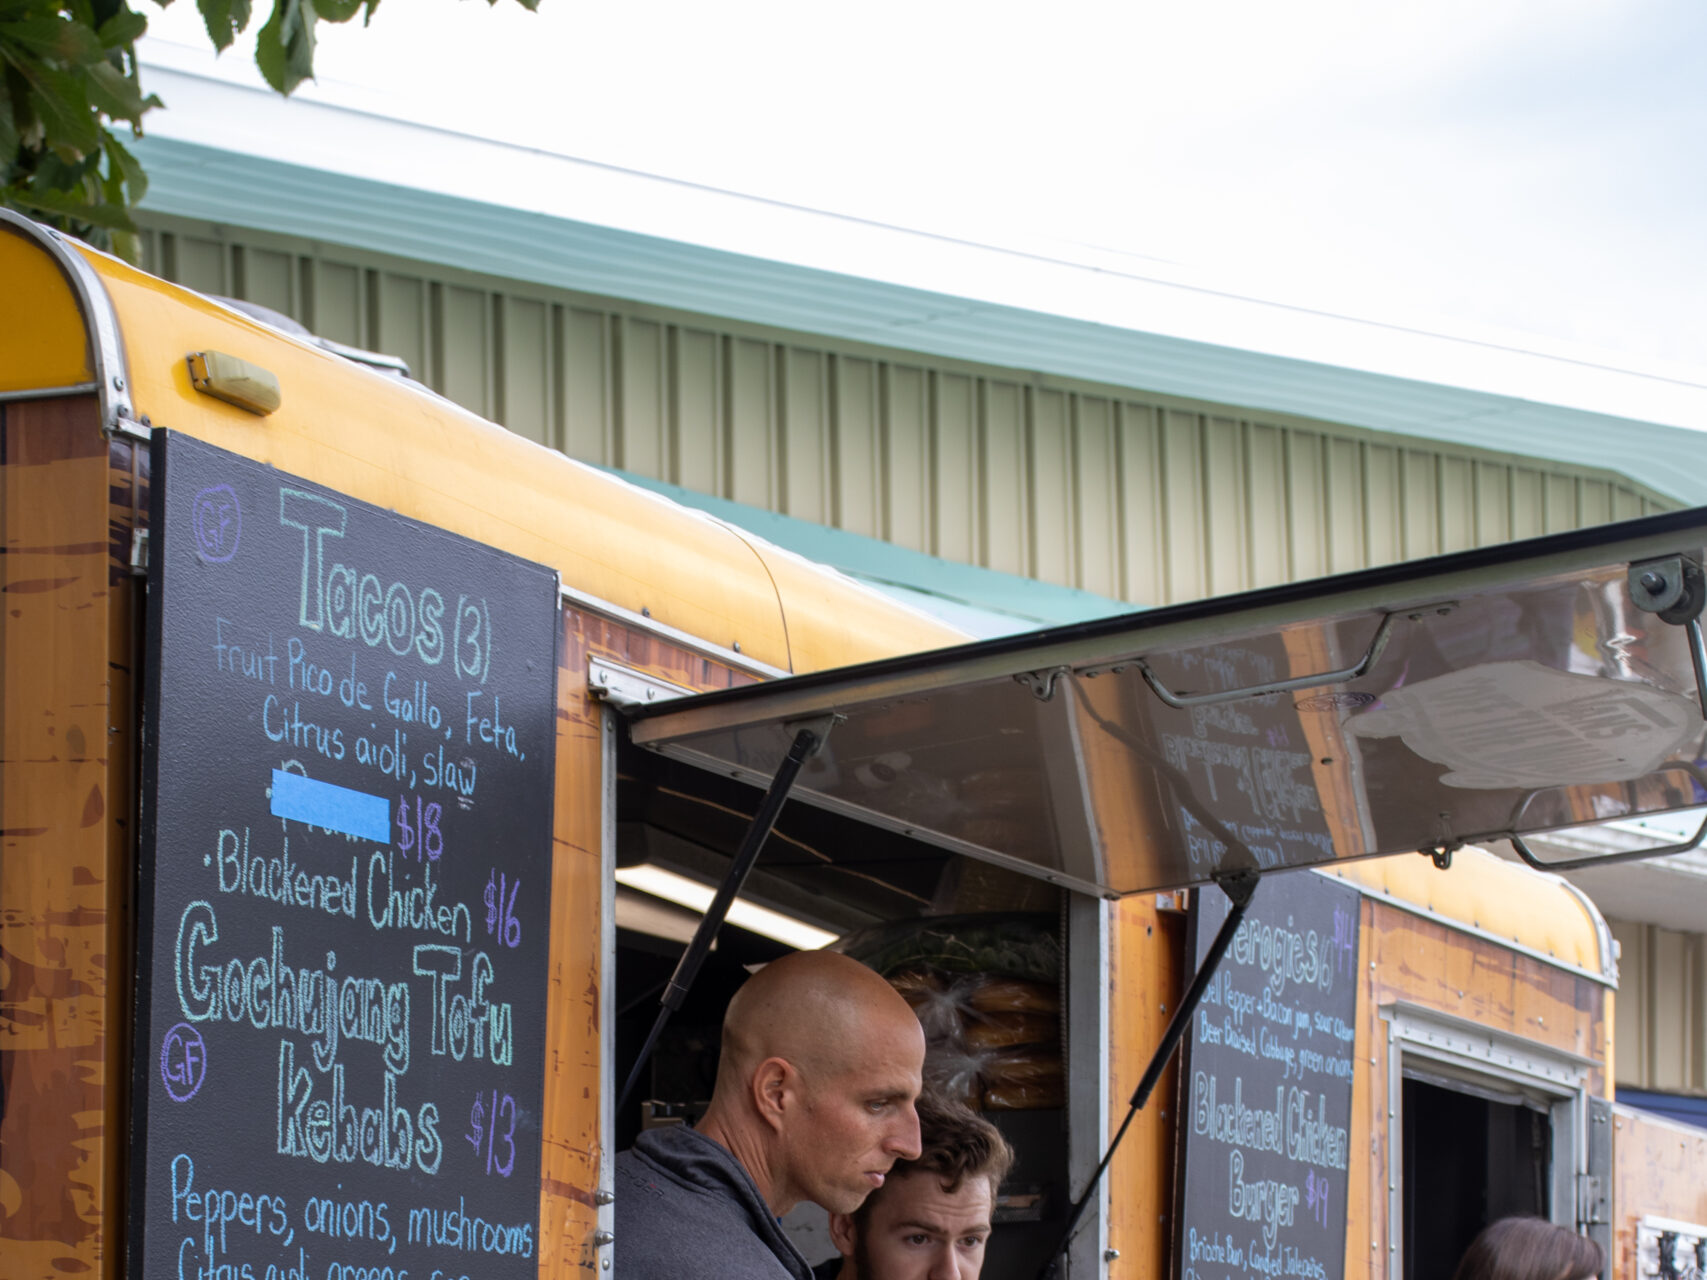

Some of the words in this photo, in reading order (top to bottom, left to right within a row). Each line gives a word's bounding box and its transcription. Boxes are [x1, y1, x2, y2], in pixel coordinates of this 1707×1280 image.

[280, 487, 445, 667] Tacos
[454, 594, 492, 684] (3)
[214, 617, 278, 686] Fruit
[288, 638, 333, 695] Pico
[340, 652, 373, 710] de
[384, 671, 453, 741] Gallo,
[467, 690, 526, 762] Feta,
[263, 694, 346, 761] Citrus
[355, 722, 417, 790] aioli,
[424, 745, 477, 796] slaw
[396, 795, 444, 863] $18
[217, 826, 358, 920] Blackened
[367, 850, 472, 943] Chicken
[483, 867, 522, 948] $16
[174, 900, 411, 1075] Gochujang
[412, 944, 513, 1067] Tofu
[163, 1028, 203, 1092] GF
[1200, 1010, 1222, 1044] Beer
[1298, 1049, 1324, 1080] green
[276, 1038, 444, 1176] Kebabs
[464, 1089, 517, 1177] $13
[1194, 1071, 1283, 1155] Blackened
[1286, 1086, 1347, 1170] Chicken
[171, 1153, 295, 1254] Peppers,
[304, 1183, 397, 1255] onions,
[408, 1195, 534, 1258] mushrooms
[1229, 1149, 1300, 1250] Burger
[1305, 1169, 1329, 1230] $19
